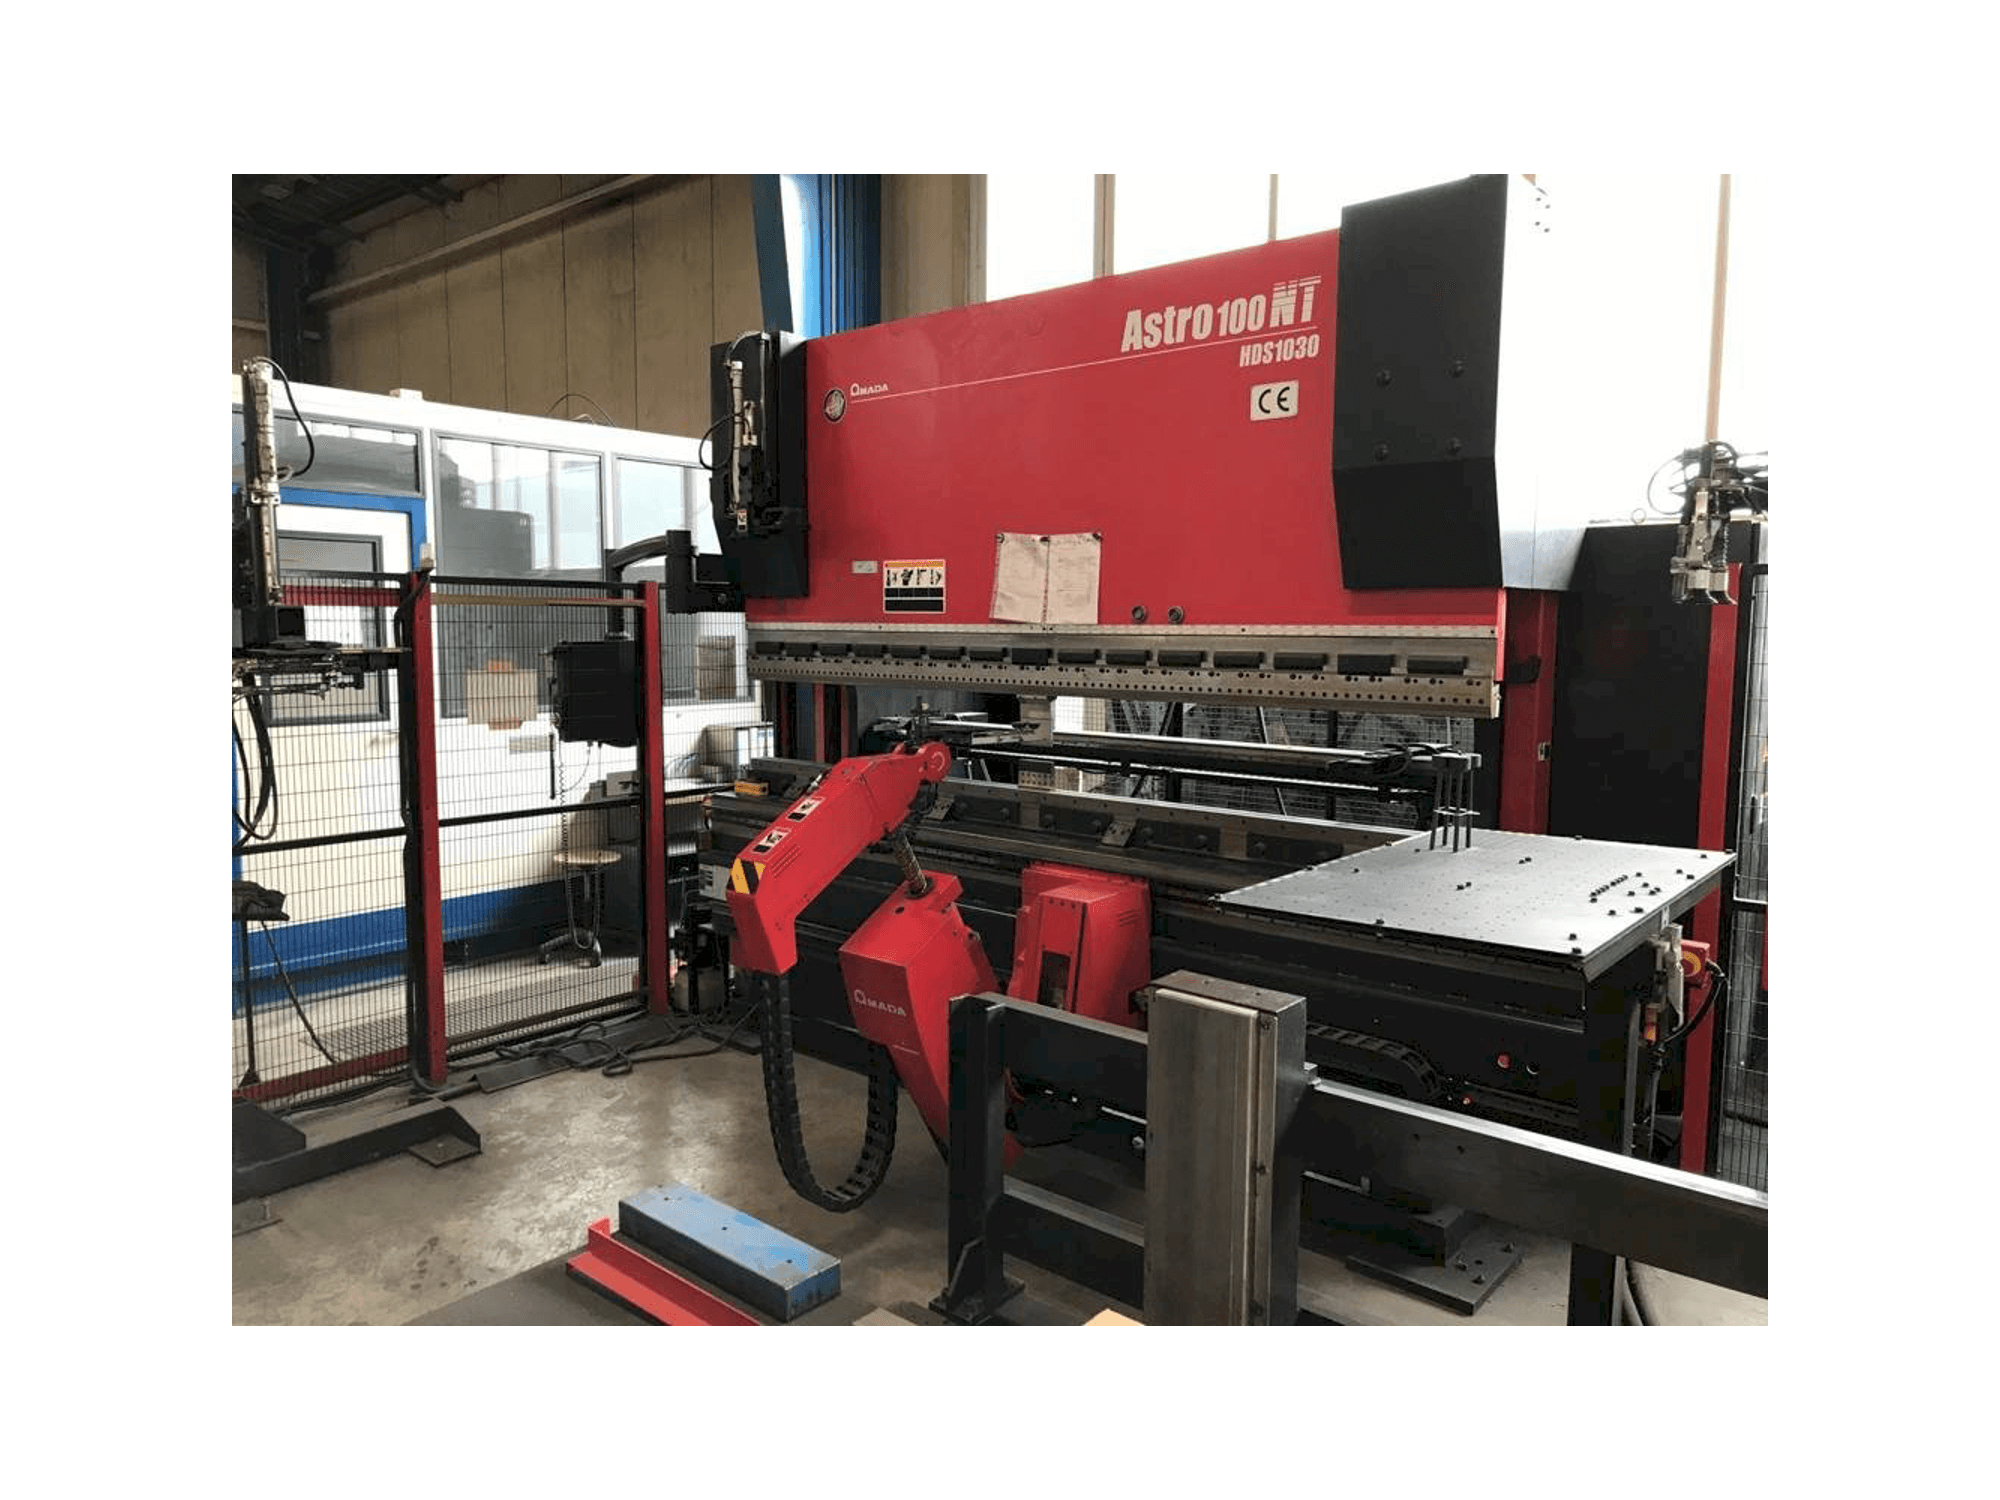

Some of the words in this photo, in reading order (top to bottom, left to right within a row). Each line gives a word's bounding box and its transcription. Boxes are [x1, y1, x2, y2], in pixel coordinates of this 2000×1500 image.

[1121, 303, 1214, 353] Astro
[1217, 294, 1267, 337] 100
[1269, 275, 1322, 328] NT
[1239, 334, 1320, 368] HDS1030
[1258, 386, 1291, 414] CE
